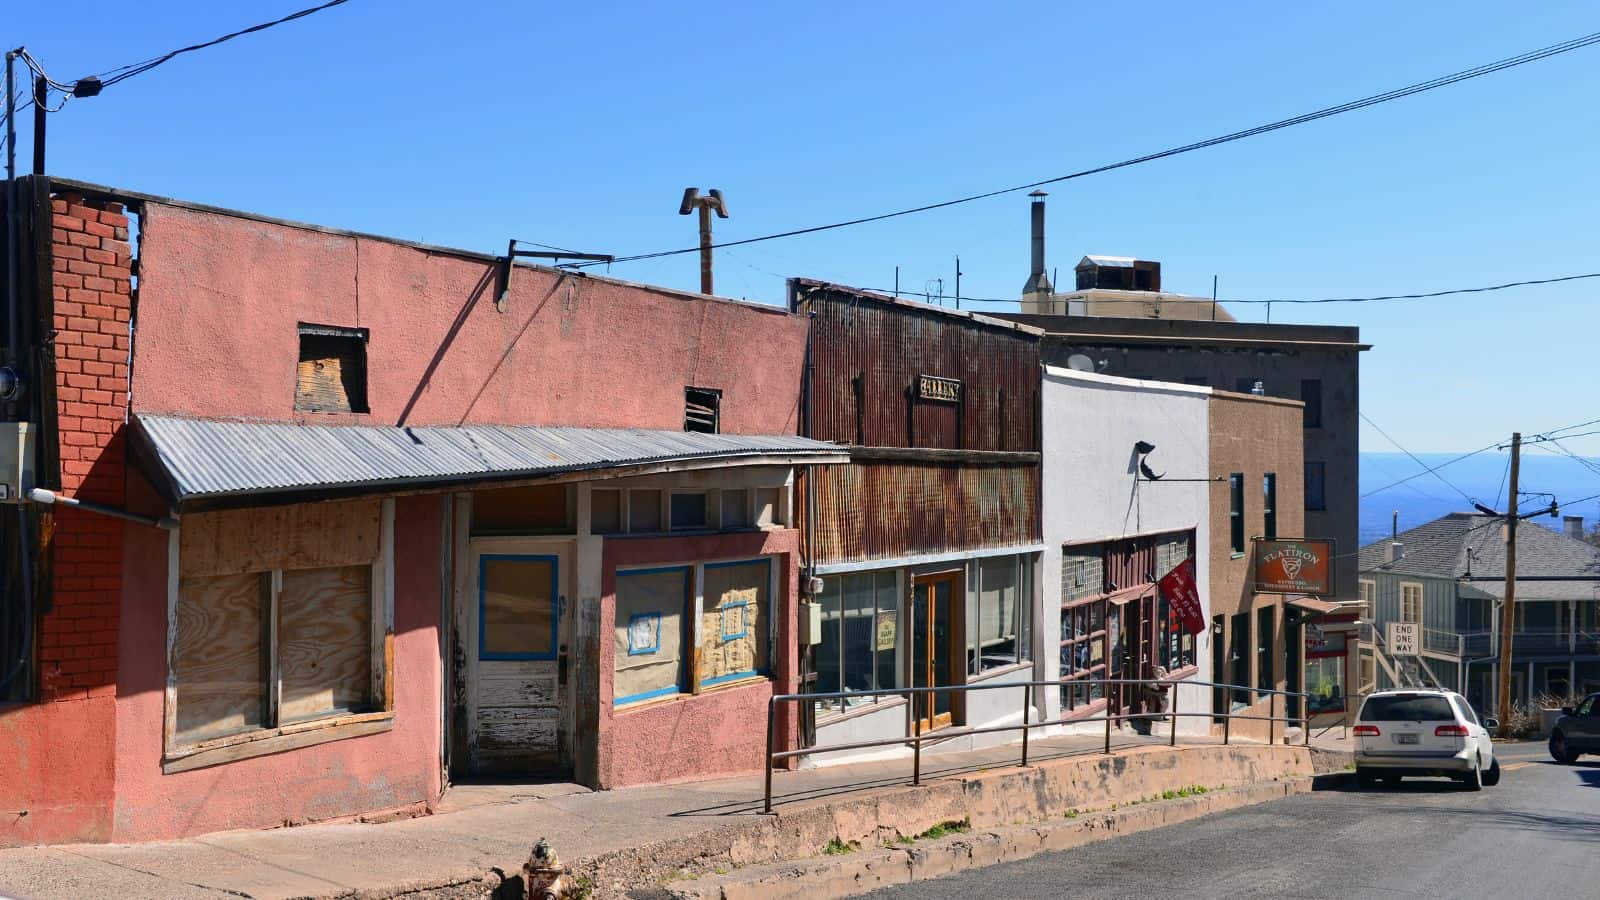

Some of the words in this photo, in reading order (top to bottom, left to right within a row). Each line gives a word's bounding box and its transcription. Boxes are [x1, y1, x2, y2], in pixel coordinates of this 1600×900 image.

[1263, 549, 1320, 564] FLATIRON
[1396, 625, 1412, 633] END
[1396, 635, 1411, 643] ONE
[1396, 644, 1412, 652] WAY
